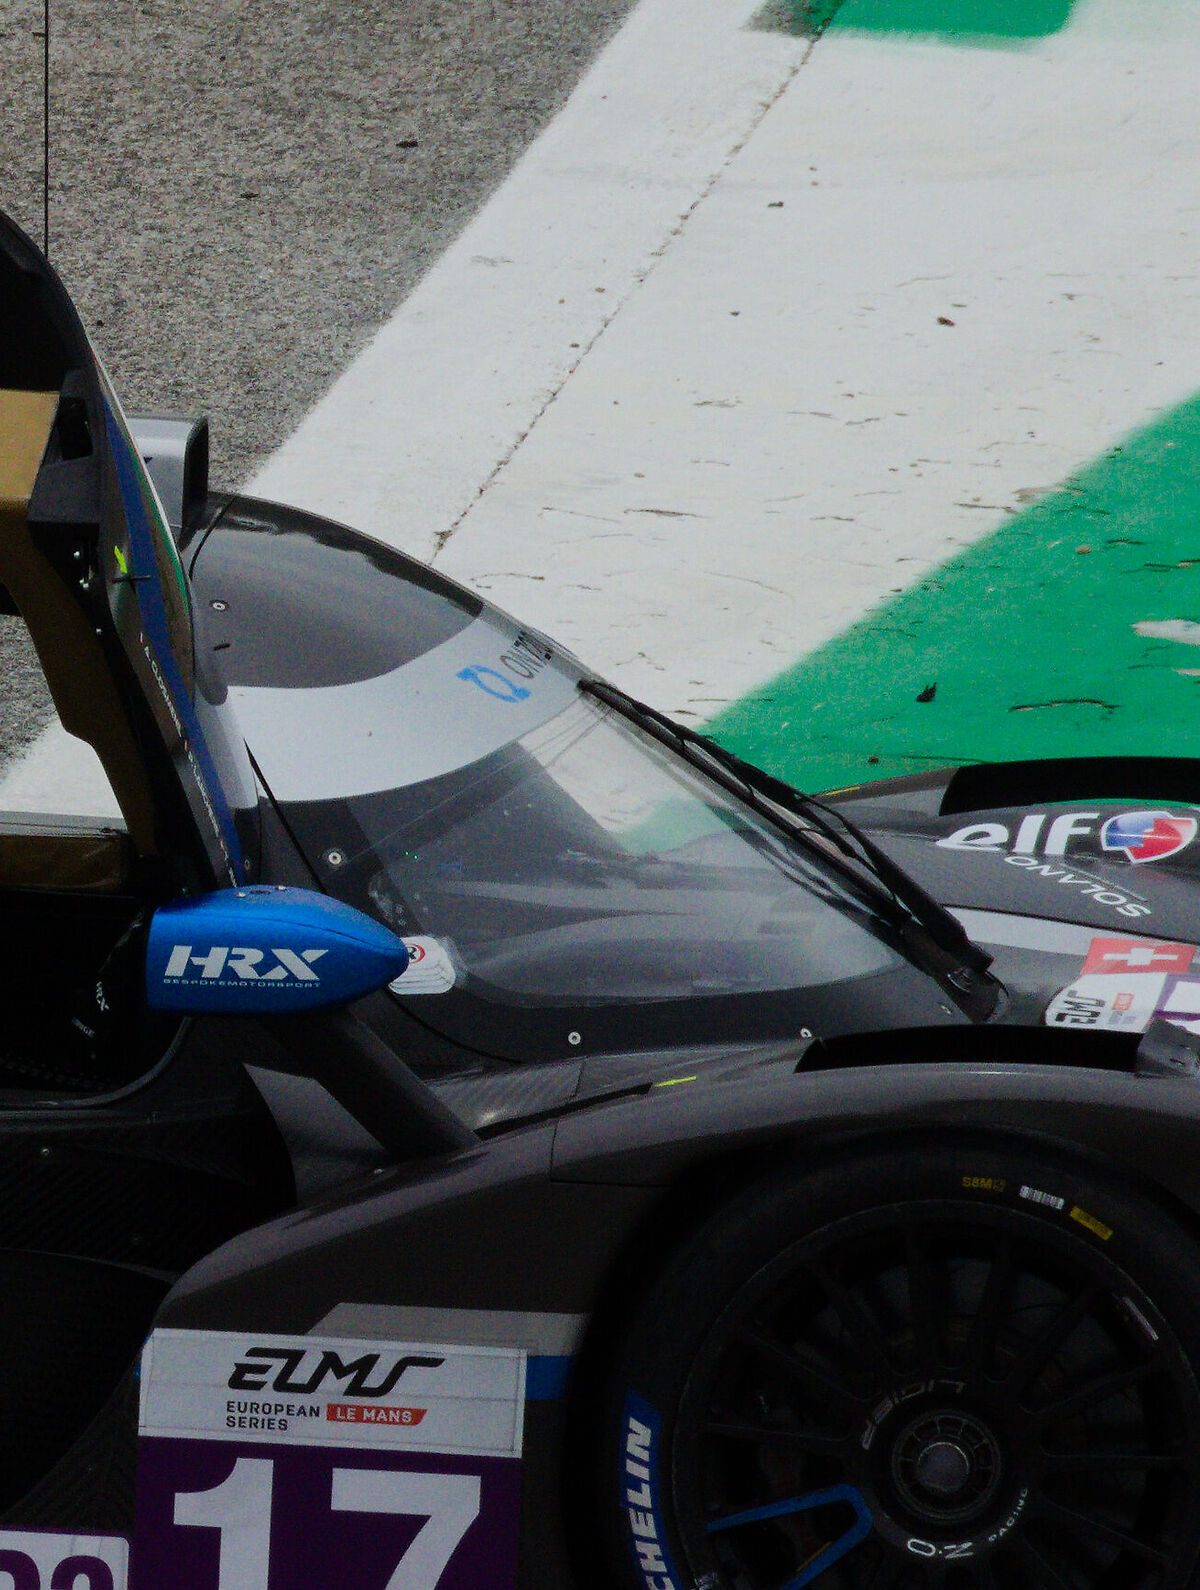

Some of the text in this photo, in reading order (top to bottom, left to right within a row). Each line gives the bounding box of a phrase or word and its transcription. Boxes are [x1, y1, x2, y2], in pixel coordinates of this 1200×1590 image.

[936, 812, 1100, 855] elf
[1004, 855, 1152, 917] SOLANO
[164, 945, 329, 981] HRX
[226, 1401, 413, 1423] EUROPEAN LE MANS
[226, 1416, 288, 1431] SERIES
[173, 1457, 482, 1590] 17
